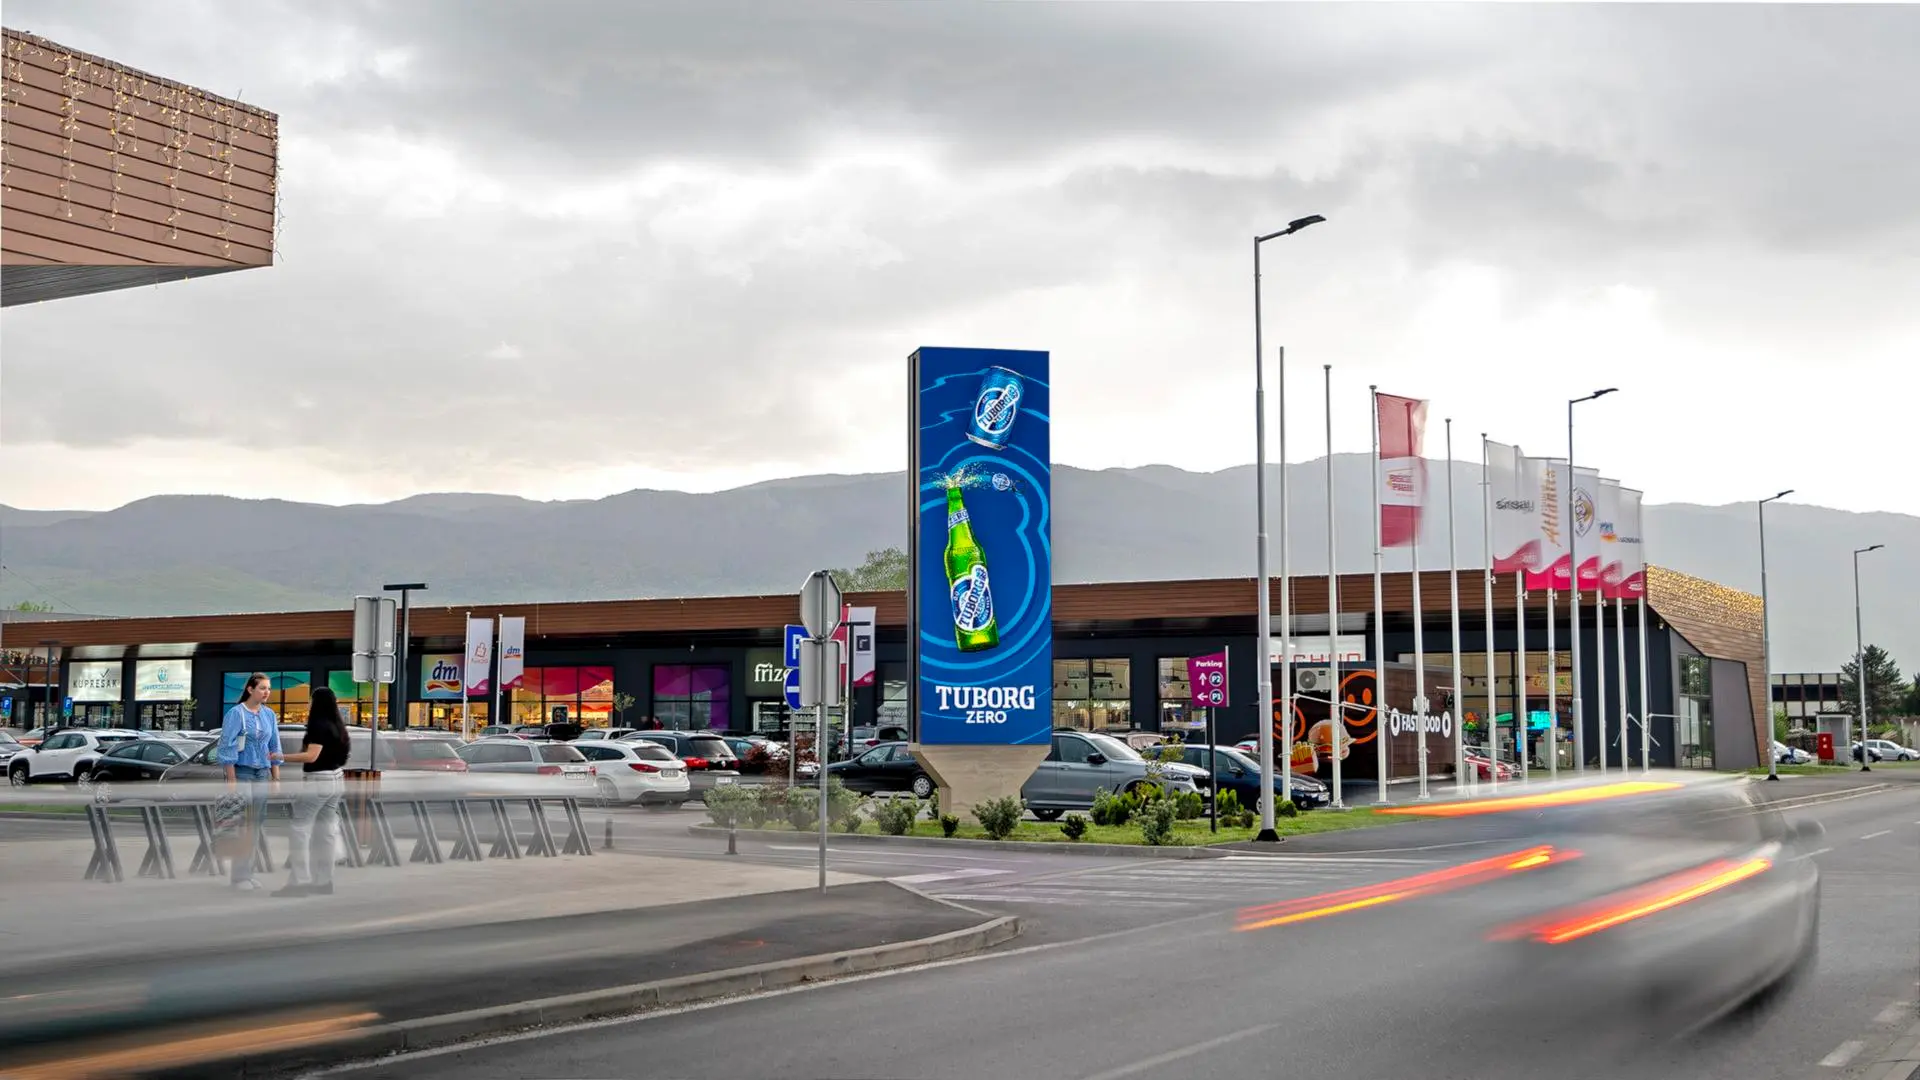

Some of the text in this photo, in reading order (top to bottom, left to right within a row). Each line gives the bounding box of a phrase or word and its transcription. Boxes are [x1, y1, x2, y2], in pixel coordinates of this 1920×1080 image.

[960, 579, 987, 627] TUBORG
[507, 646, 520, 655] dm
[432, 660, 458, 680] dm
[1196, 660, 1223, 668] Parking
[1211, 675, 1221, 683] P2
[935, 685, 1035, 710] TUBORG
[965, 710, 1007, 724] ZERO
